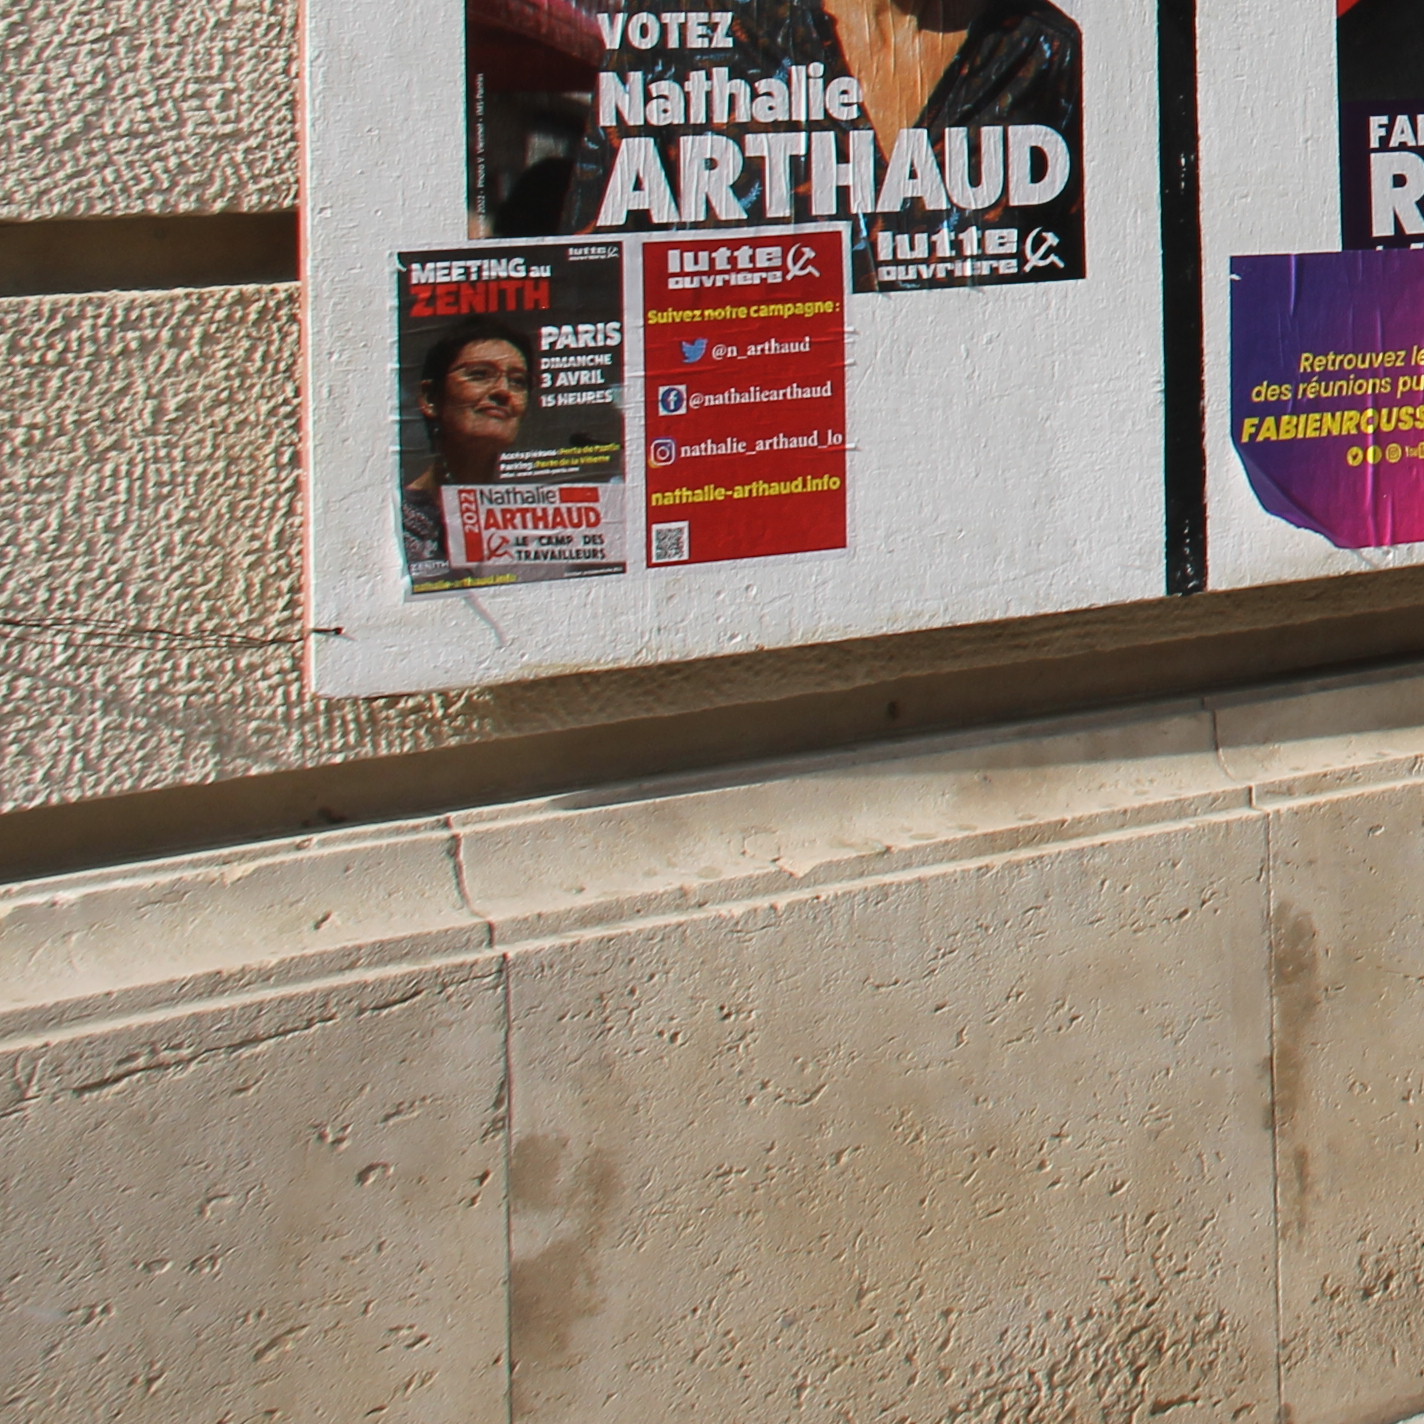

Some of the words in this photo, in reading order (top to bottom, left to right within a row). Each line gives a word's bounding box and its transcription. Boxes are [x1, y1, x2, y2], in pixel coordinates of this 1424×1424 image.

[597, 11, 734, 50] VOTEZ
[598, 62, 863, 127] Nathalie
[596, 124, 1071, 227] ARTHAUD
[877, 226, 1018, 261] lutte
[410, 258, 526, 284] MEETING
[530, 265, 551, 277] au
[667, 245, 782, 273] lutte
[410, 280, 550, 317] ZENITH
[647, 308, 702, 324] Suivez
[704, 305, 747, 321] notre
[750, 300, 834, 320] campagne
[540, 322, 622, 351] PARIS
[711, 336, 810, 361] @n_arthaud
[541, 354, 612, 369] DIMANCHE
[1299, 348, 1406, 373] Retrouvez
[541, 374, 552, 388] 3
[556, 370, 605, 386] AVRIL
[1251, 380, 1292, 402] des
[1297, 373, 1392, 399] réunions
[541, 394, 555, 407] 15
[557, 389, 613, 406] HEURES
[689, 381, 832, 409] @nathaliearthaud
[680, 429, 843, 457] nathalie_arthaud_lo
[479, 487, 557, 505] Nathalie
[651, 474, 841, 506] nathalie-arthaud.info
[460, 493, 479, 533] 2022
[484, 506, 602, 530] ARTHAUD
[515, 536, 529, 546] LE
[537, 535, 573, 546] CAMP
[582, 533, 605, 545] DES
[516, 549, 606, 561] TRAVAILLEURS
